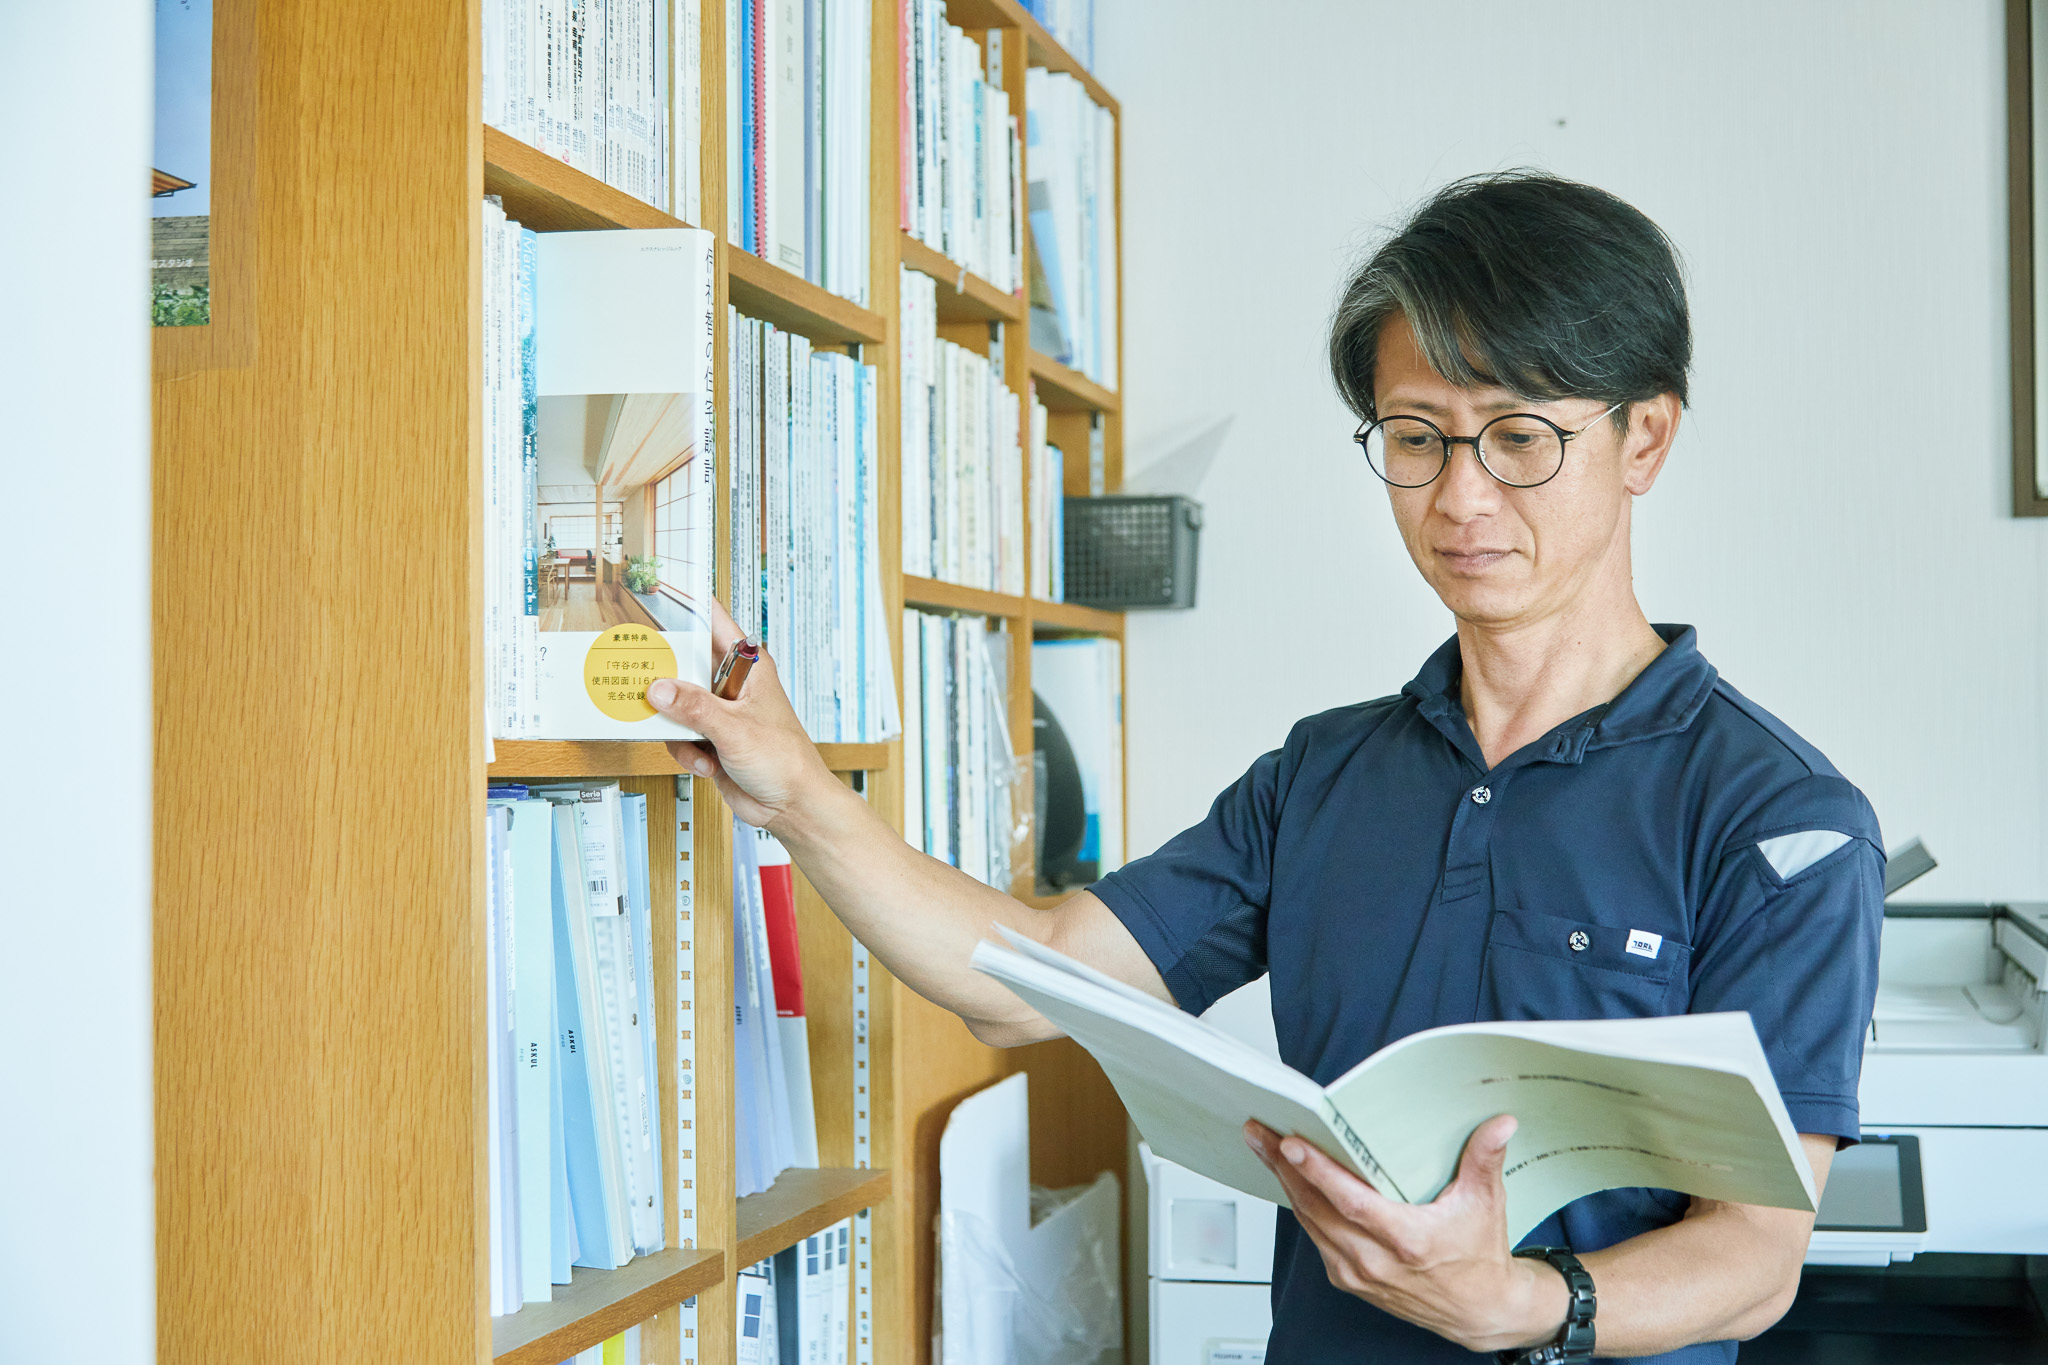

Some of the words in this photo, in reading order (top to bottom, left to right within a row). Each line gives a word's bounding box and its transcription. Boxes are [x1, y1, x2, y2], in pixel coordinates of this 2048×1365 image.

[521, 236, 532, 330] Maruyam
[613, 633, 648, 642] 豪華特典
[592, 676, 666, 686] 使用図面116
[608, 691, 646, 701] 完全収録
[581, 790, 601, 798] Seria
[567, 1029, 577, 1054] ASKUL
[530, 1042, 538, 1069] ASKUL
